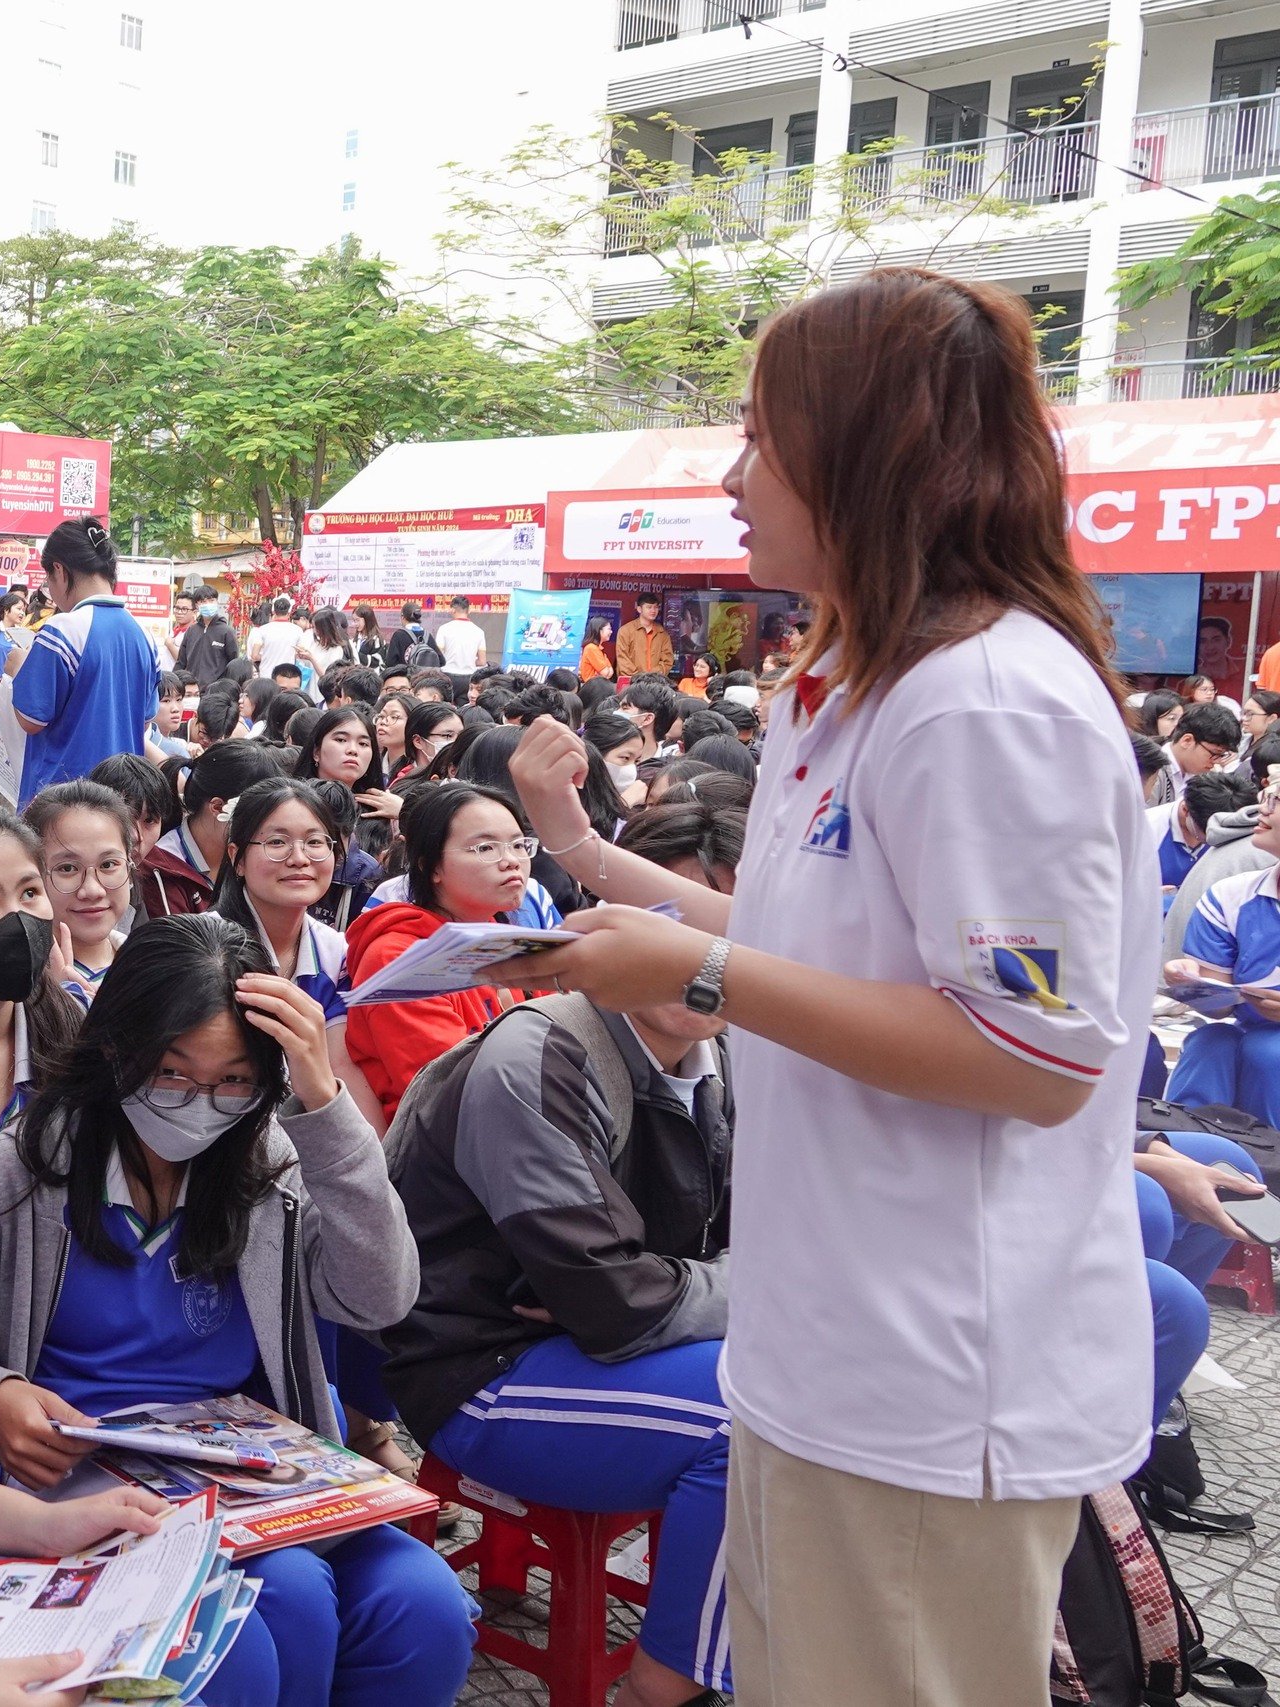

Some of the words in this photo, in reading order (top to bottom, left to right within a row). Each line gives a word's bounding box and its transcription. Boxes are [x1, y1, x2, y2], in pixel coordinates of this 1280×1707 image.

[1, 499, 54, 513] tuyensinhDTU
[63, 509, 79, 517] SCAN
[325, 513, 355, 525] TRƯỜNG
[355, 514, 368, 526] ĐẠI
[370, 513, 385, 526] HỌC
[386, 511, 405, 525] LUẬT,
[422, 510, 437, 524] HỌC
[504, 508, 533, 523] DHA
[618, 509, 654, 533] FPT
[657, 517, 690, 525] Education
[397, 523, 417, 533] TUYỂN
[417, 524, 431, 532] SINH
[431, 523, 445, 532] NĂM
[603, 541, 626, 551] FPT
[628, 539, 704, 551] UNIVERSITY
[577, 577, 598, 589] TRIỆU
[600, 577, 621, 590] ĐỒNG
[622, 581, 638, 593] HỌC
[1204, 582, 1254, 601] FPT
[1004, 935, 1038, 946] KHOA
[310, 1505, 336, 1519] SAO
[338, 1500, 363, 1512] TẠI
[254, 1512, 311, 1531] KHÔNG?
